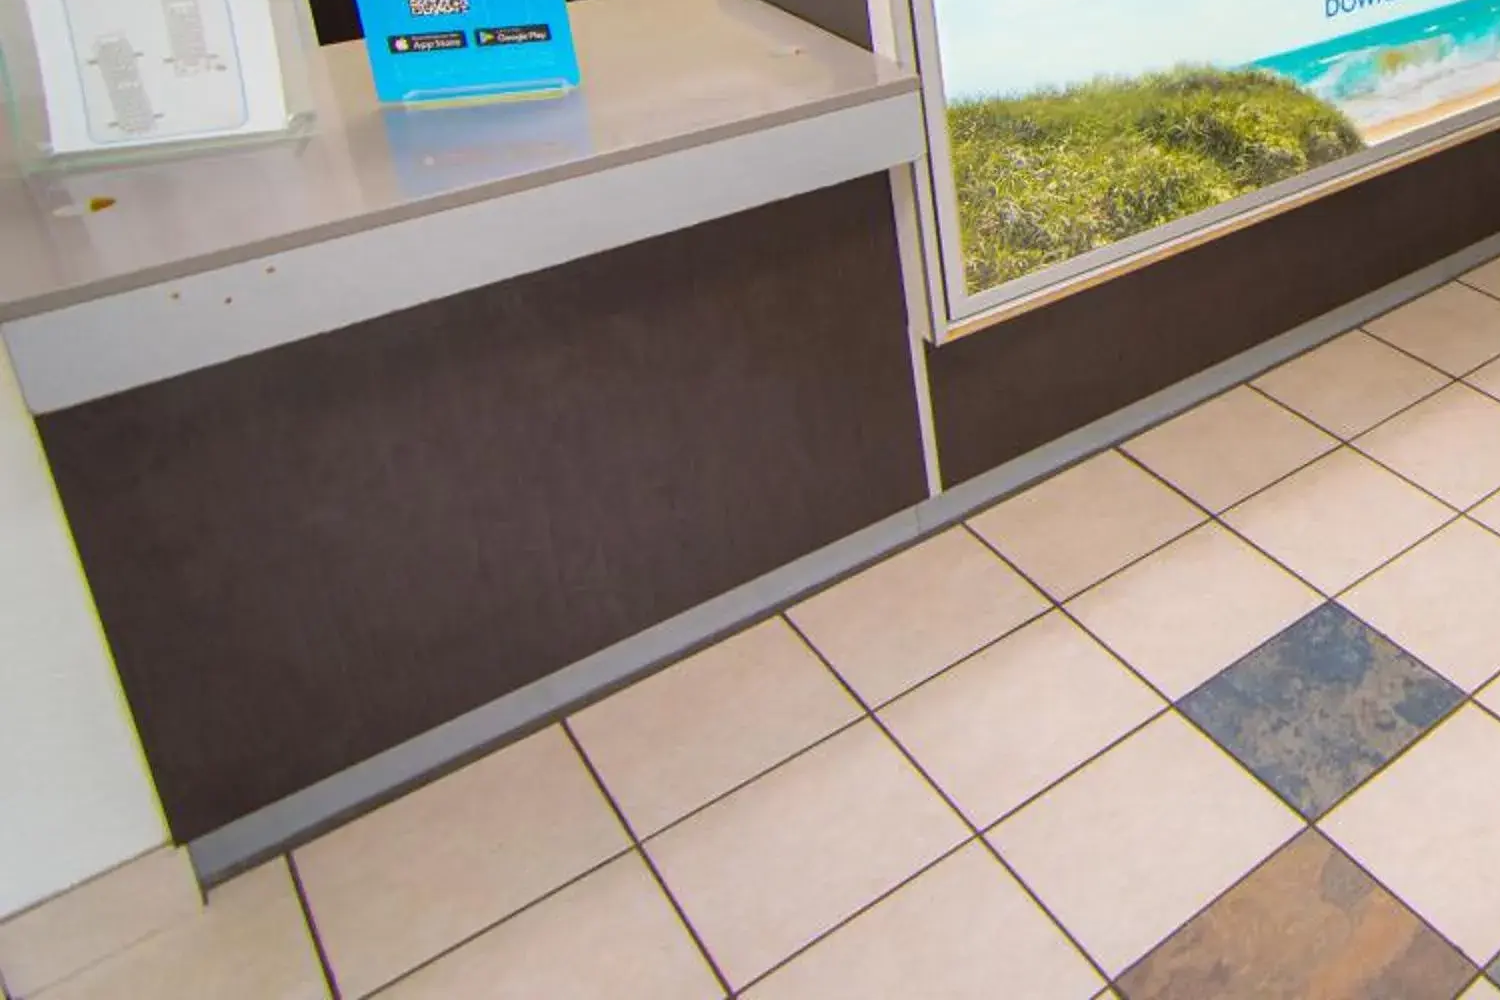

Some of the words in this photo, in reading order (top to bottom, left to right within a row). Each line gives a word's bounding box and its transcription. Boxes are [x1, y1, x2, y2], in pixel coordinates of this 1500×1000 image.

[497, 33, 526, 44] Google
[529, 30, 547, 41] Play
[413, 40, 432, 52] App
[434, 38, 461, 48] Store
